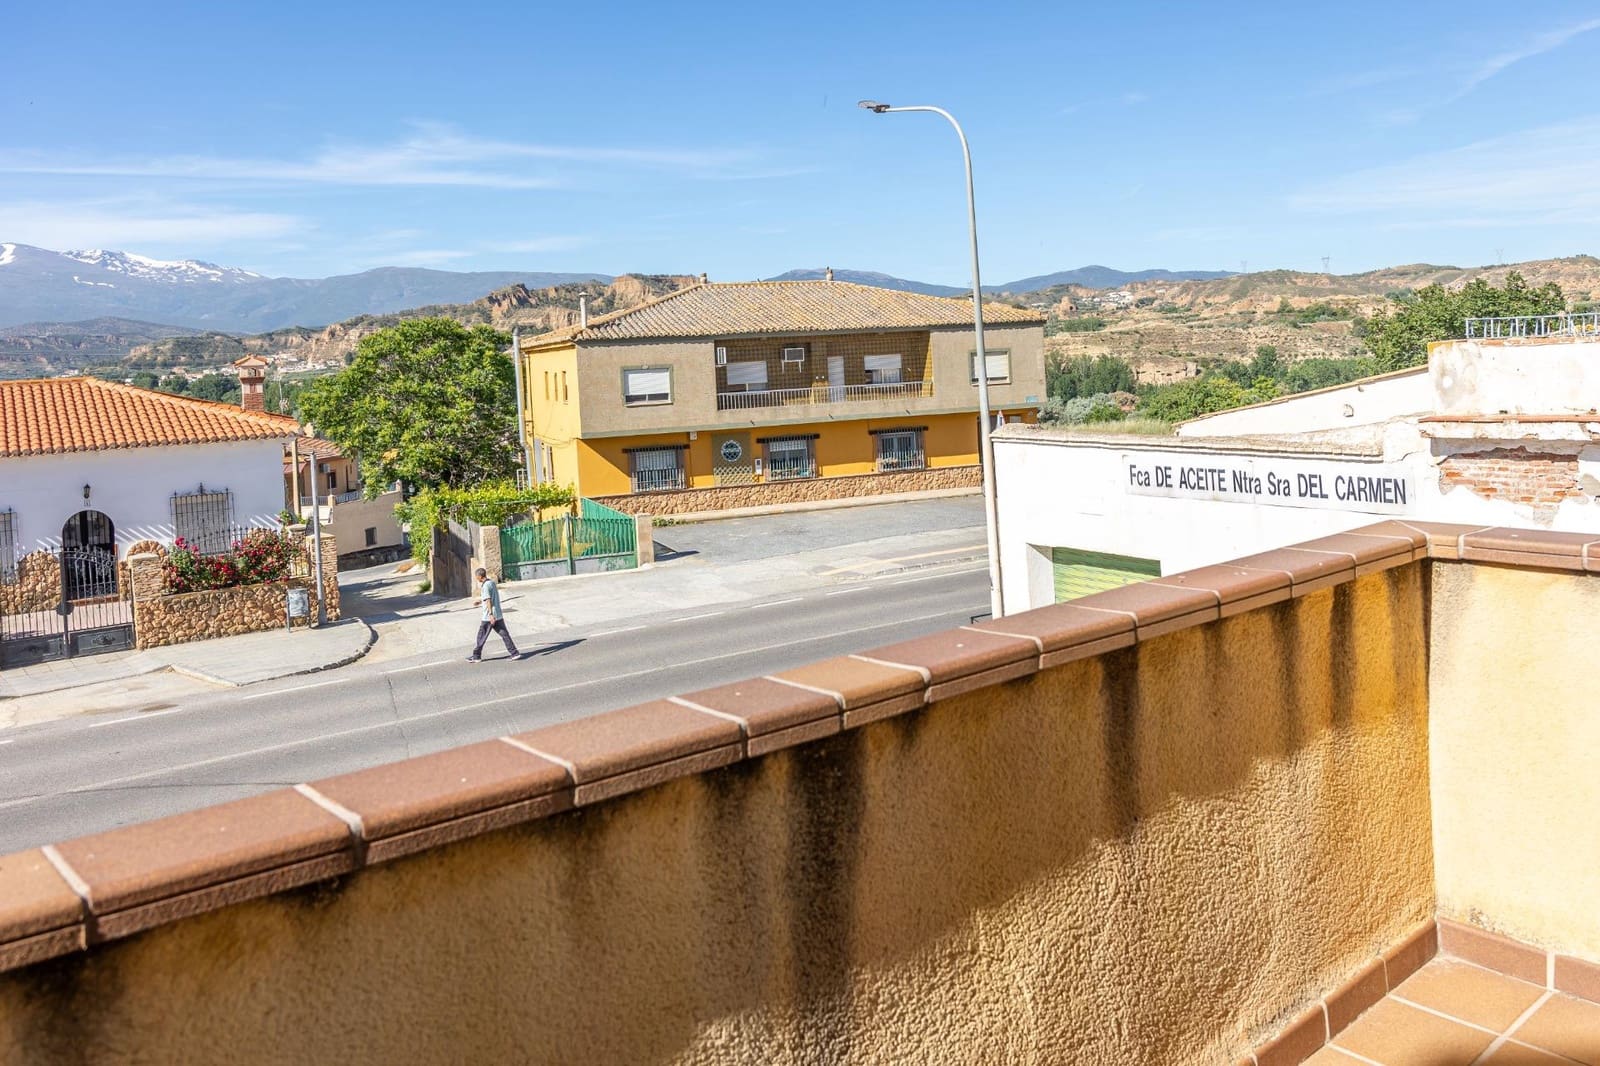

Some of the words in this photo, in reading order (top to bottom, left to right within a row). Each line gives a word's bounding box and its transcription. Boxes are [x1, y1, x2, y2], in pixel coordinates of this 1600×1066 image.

[1129, 464, 1151, 487] Fca
[1155, 466, 1173, 489] DE
[1179, 467, 1227, 492] ACEITE
[1232, 470, 1262, 495] Ntra
[1267, 472, 1291, 497] Sra
[1298, 473, 1329, 499] DEL
[1335, 475, 1407, 505] CARMEN
